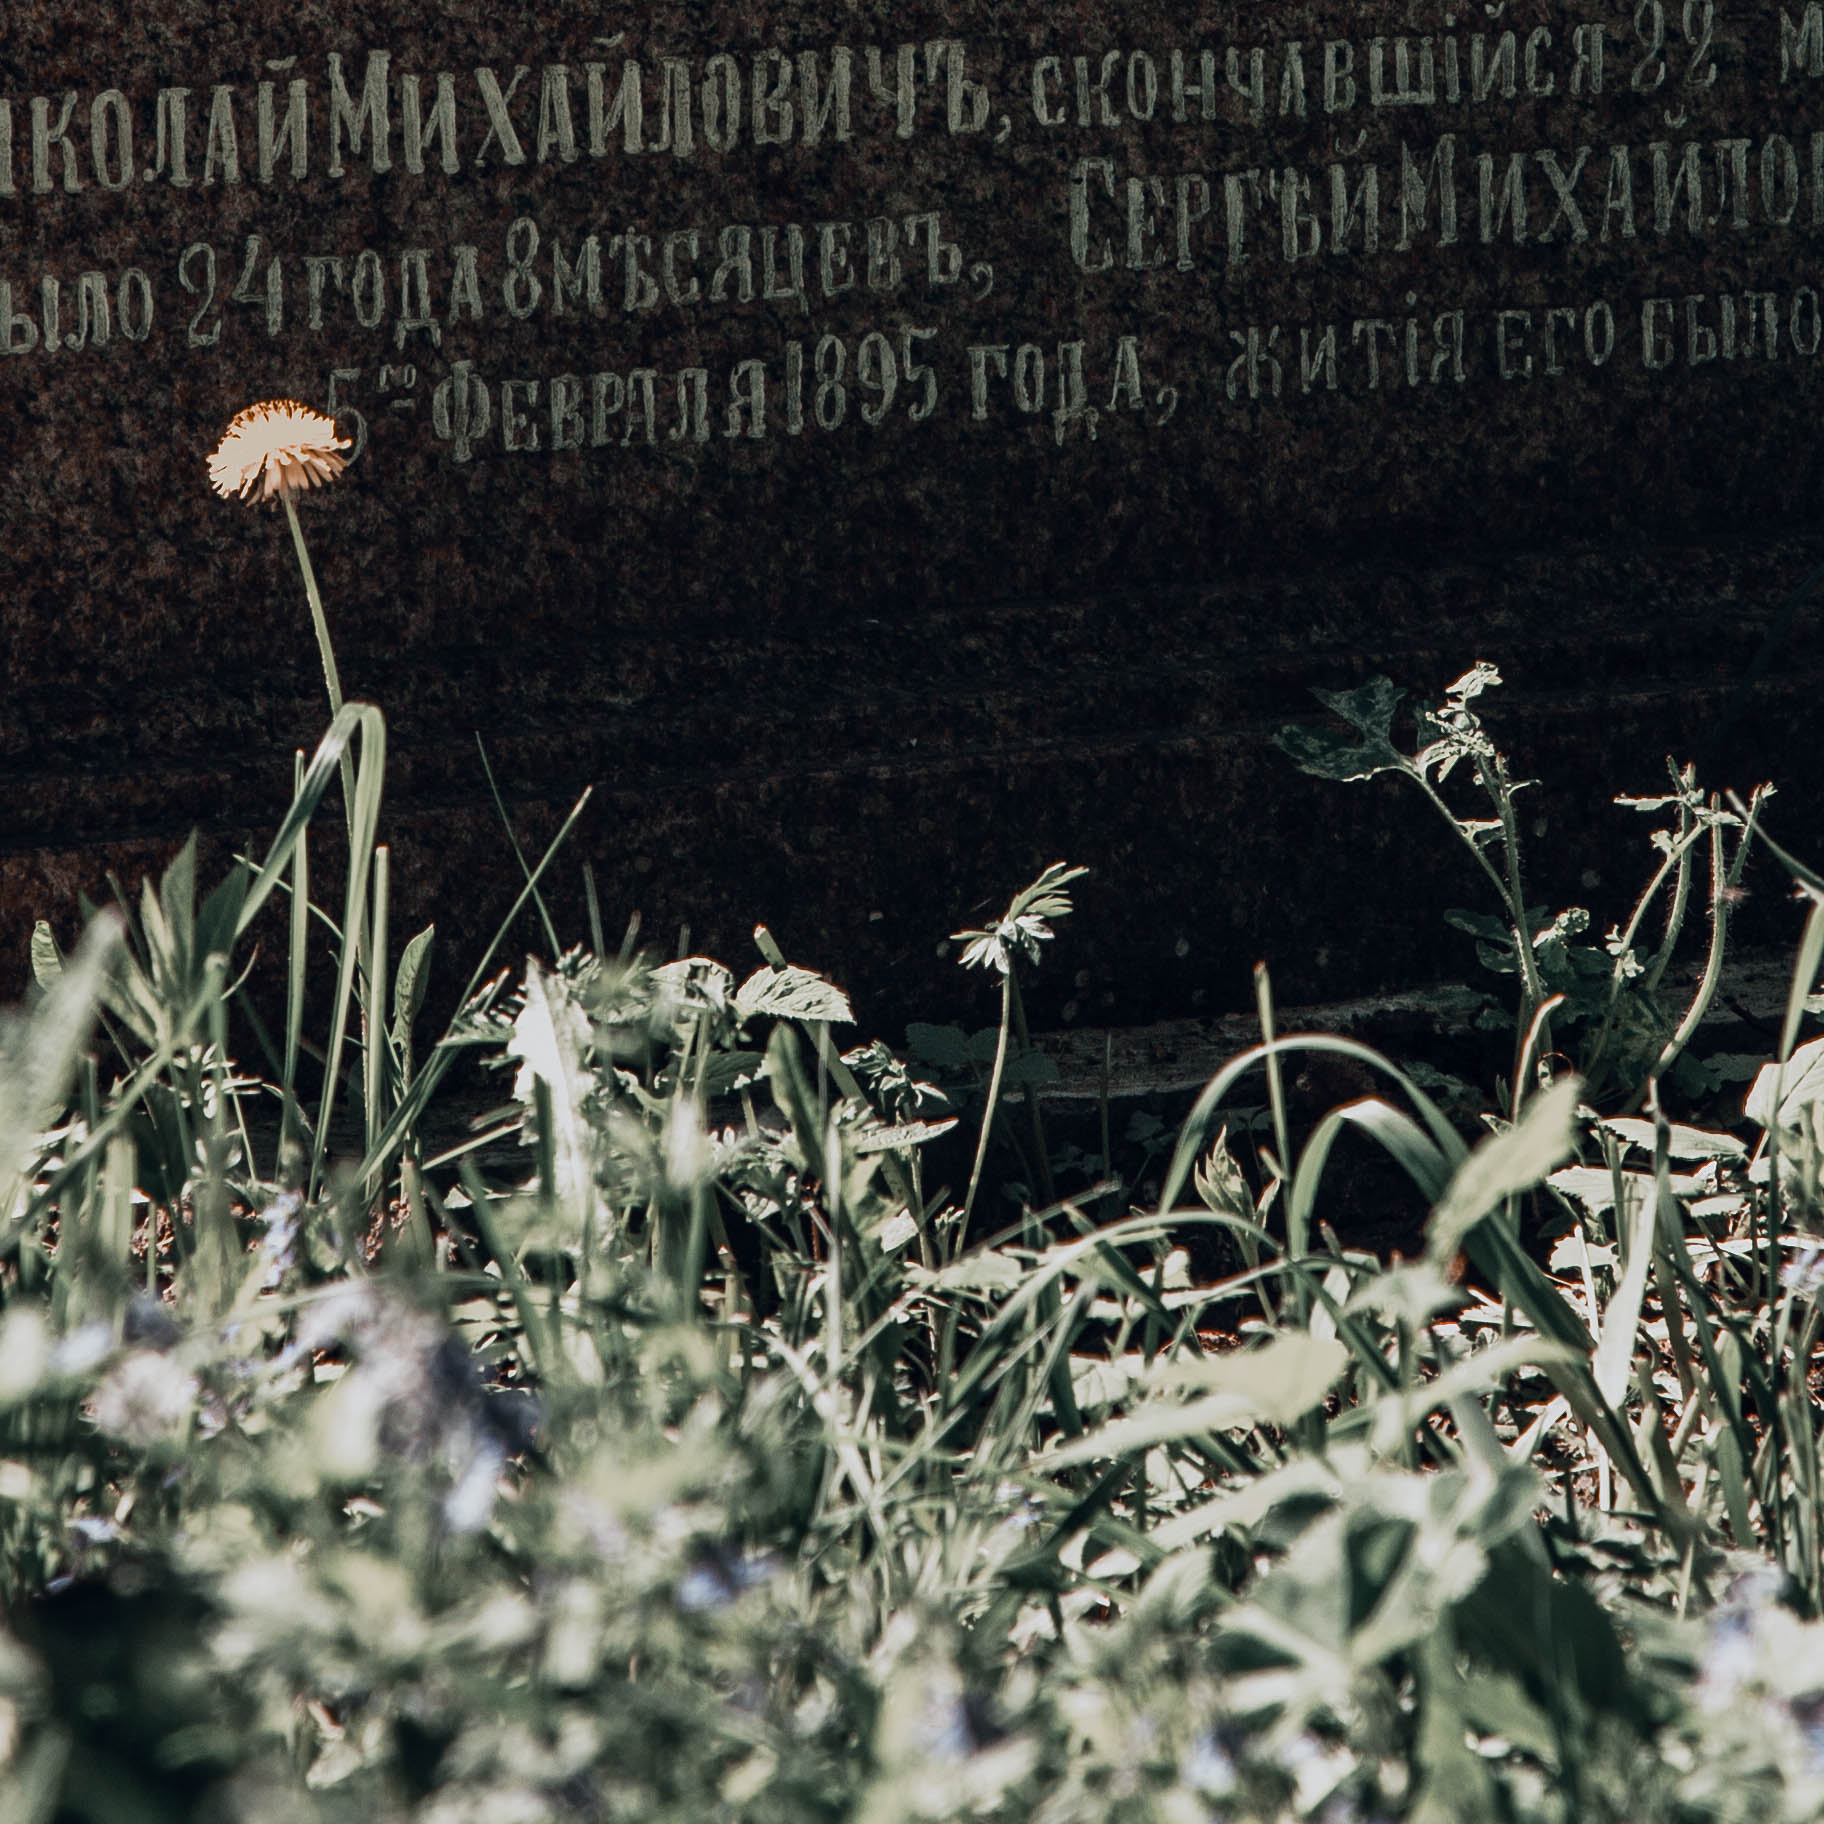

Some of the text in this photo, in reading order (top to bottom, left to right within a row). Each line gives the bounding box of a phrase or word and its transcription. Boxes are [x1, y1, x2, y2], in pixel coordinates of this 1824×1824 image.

[178, 233, 284, 349] 24
[501, 216, 543, 321] 8
[785, 324, 940, 436] 1895
